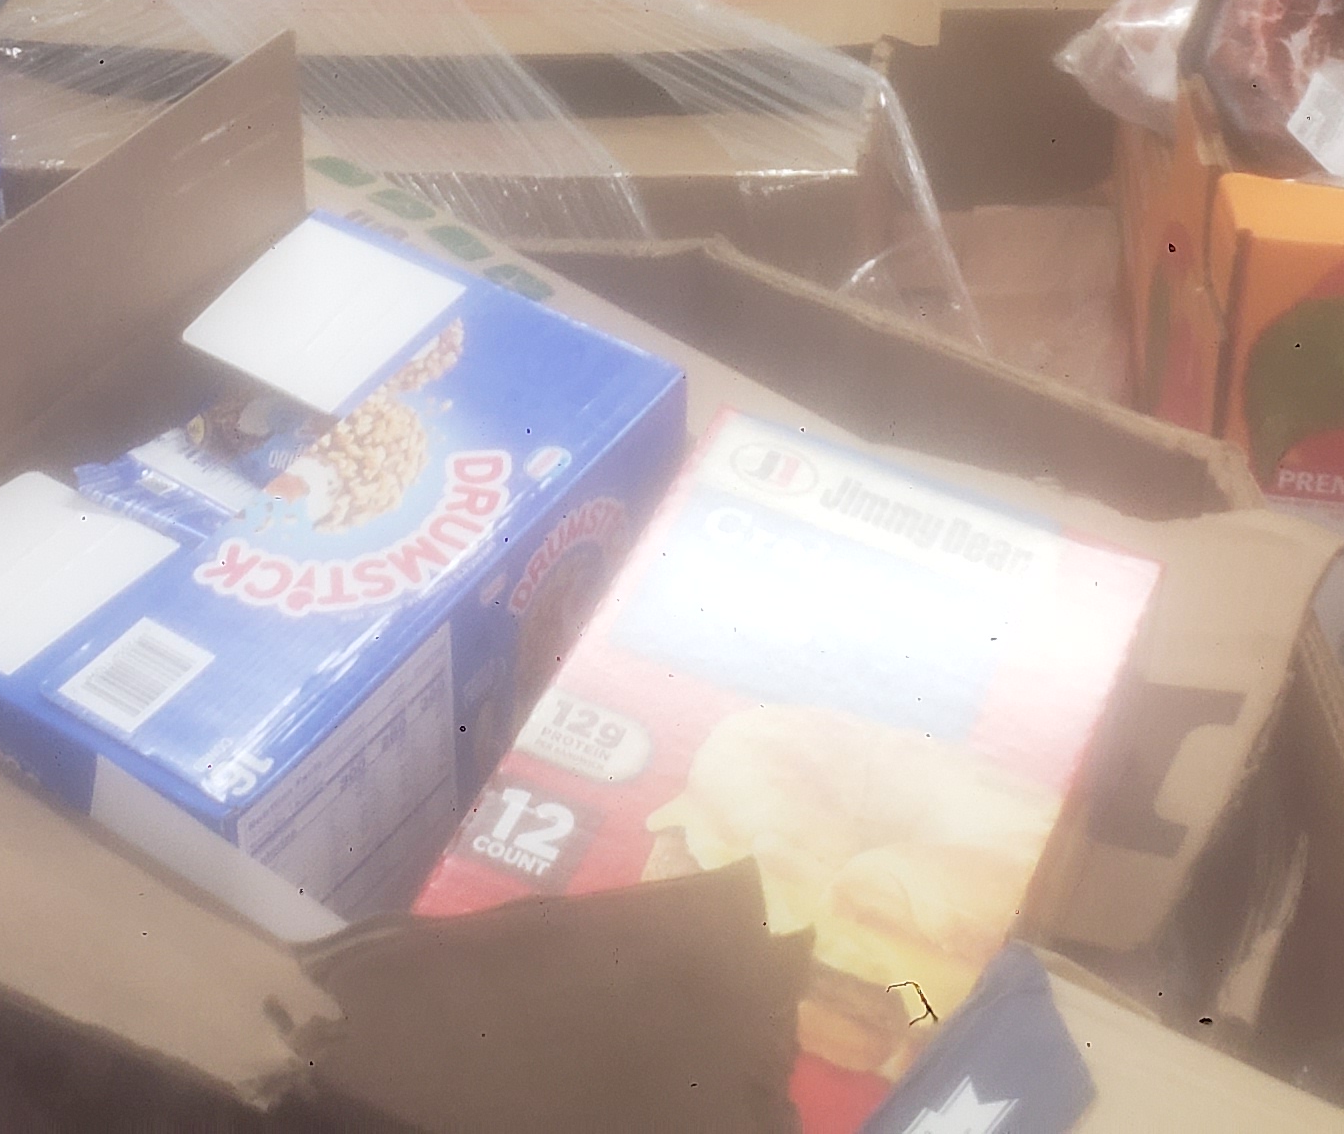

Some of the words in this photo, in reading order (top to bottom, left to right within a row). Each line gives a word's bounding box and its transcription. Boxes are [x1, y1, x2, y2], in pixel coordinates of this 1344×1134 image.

[202, 453, 508, 613] DRUMSTICK
[819, 476, 945, 549] Jimmy
[540, 726, 612, 762] PROTEIN
[551, 698, 628, 750] 12g
[472, 833, 551, 877] COUNT
[491, 787, 576, 861] 12
